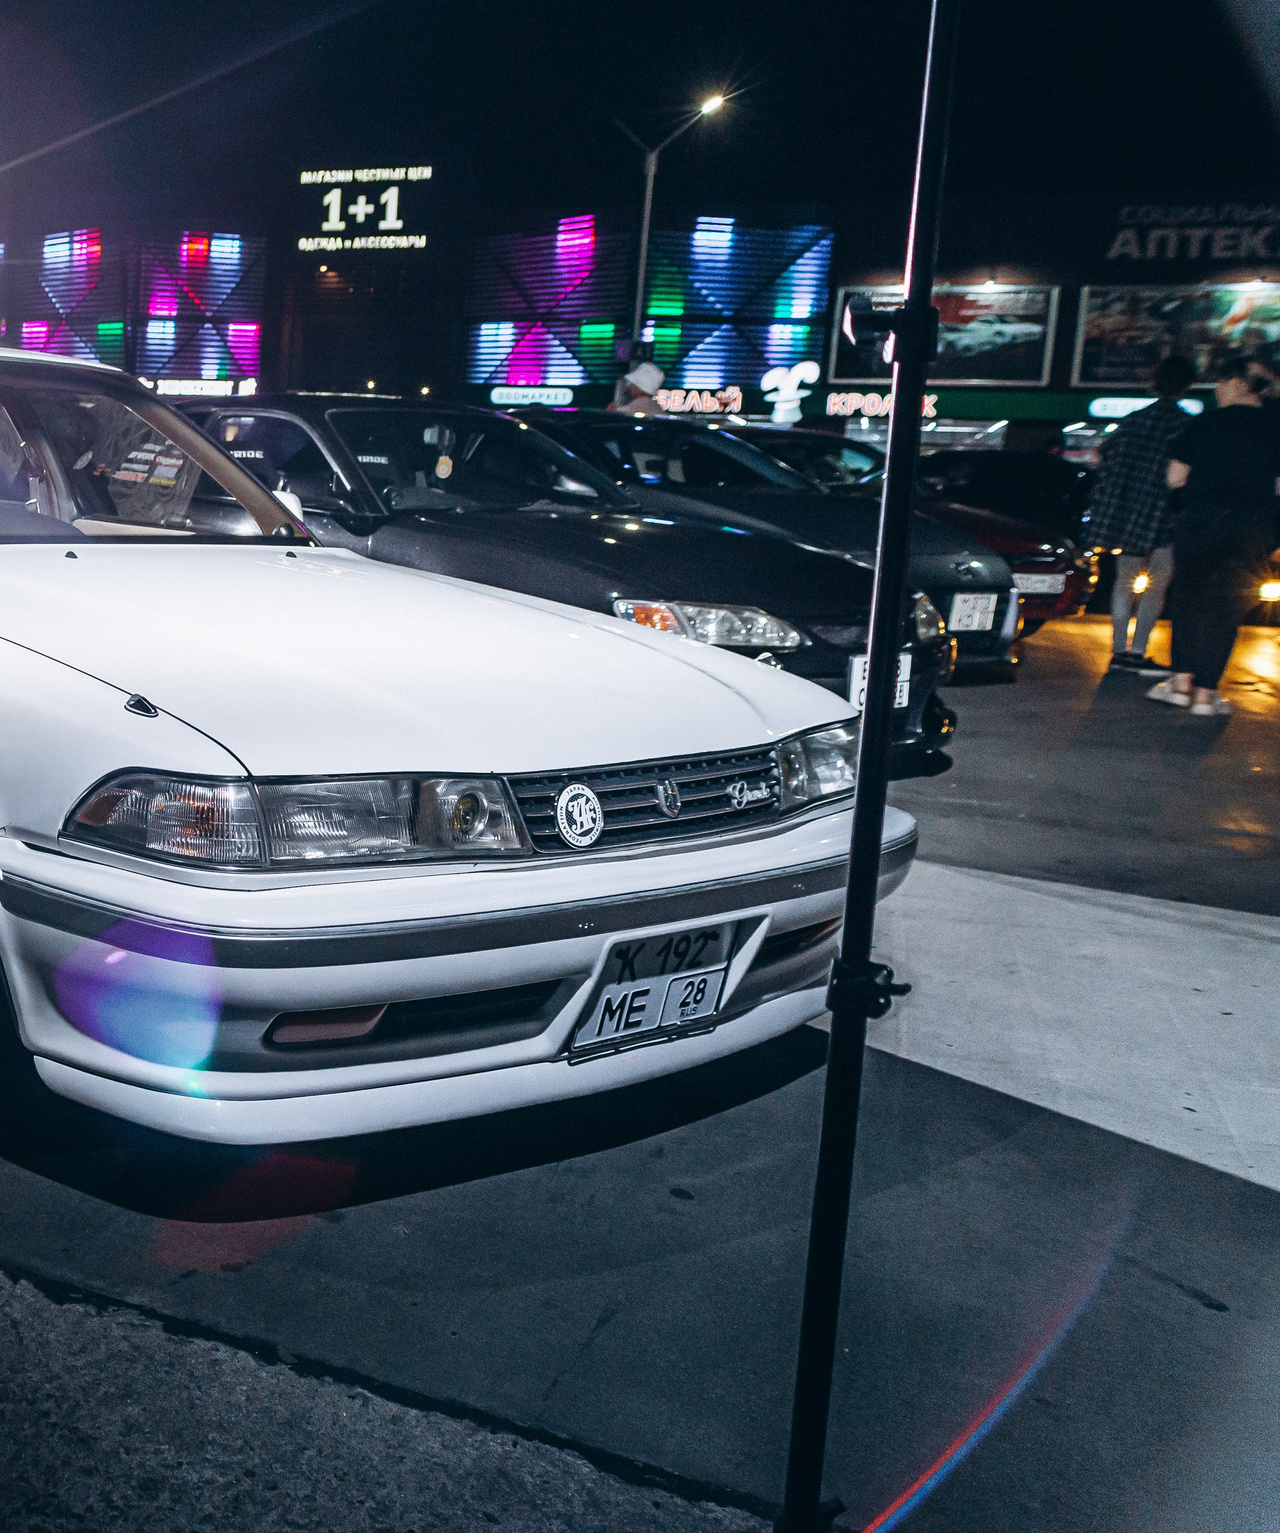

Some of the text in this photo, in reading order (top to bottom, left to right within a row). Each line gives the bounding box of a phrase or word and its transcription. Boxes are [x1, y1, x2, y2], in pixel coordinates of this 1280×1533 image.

[300, 166, 432, 184] МАГАЗИН ЧЕСТНЫХ ЦЕН
[321, 186, 404, 232] 1+1
[298, 237, 343, 251] ОДЕЖДА
[352, 235, 427, 249] АКСЕССУАРЫ
[1106, 227, 1280, 258] АПТЕК
[230, 450, 264, 459] RIDE
[656, 930, 710, 976] 192
[679, 977, 708, 1009] 28
[679, 1005, 698, 1017] RUS
